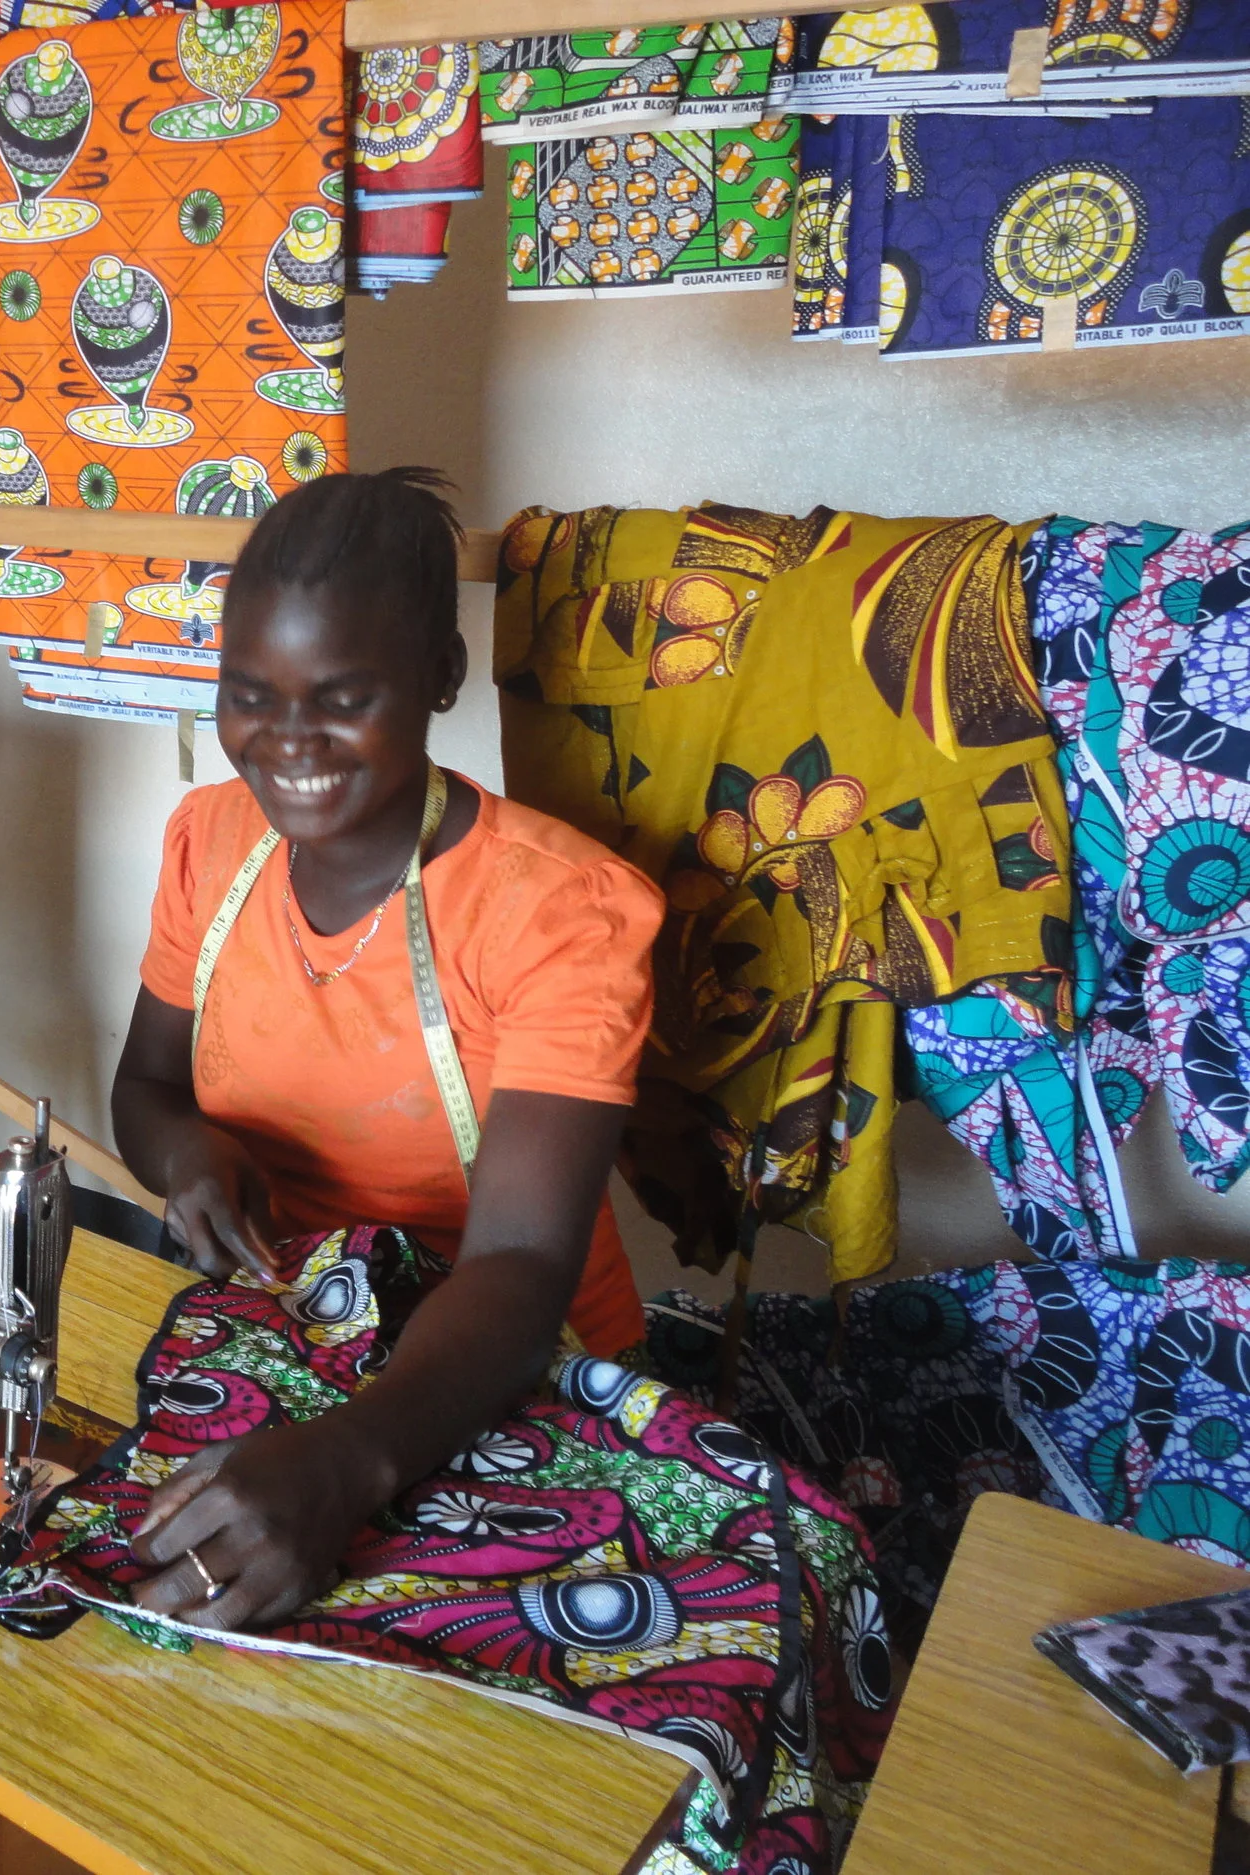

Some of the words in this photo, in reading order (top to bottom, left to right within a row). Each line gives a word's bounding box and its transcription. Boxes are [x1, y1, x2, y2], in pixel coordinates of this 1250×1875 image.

[529, 111, 579, 127] VERITABLE
[582, 107, 607, 119] REAL
[612, 101, 637, 112] WAX
[682, 272, 762, 286] GUARANTEED
[1075, 330, 1123, 342] RITABLE
[1131, 327, 1154, 338] TOP
[1160, 323, 1197, 336] QUALI
[1204, 320, 1244, 333] BLOCK
[137, 646, 173, 656] VERITABLE
[193, 652, 213, 660] QUALI
[58, 700, 95, 712] GUARANTEED
[112, 707, 131, 716] QUALI
[134, 709, 154, 718] BLOCK
[158, 712, 173, 720] WAX
[1030, 1424, 1050, 1447] WAX
[1050, 1451, 1078, 1486] BLOCK
